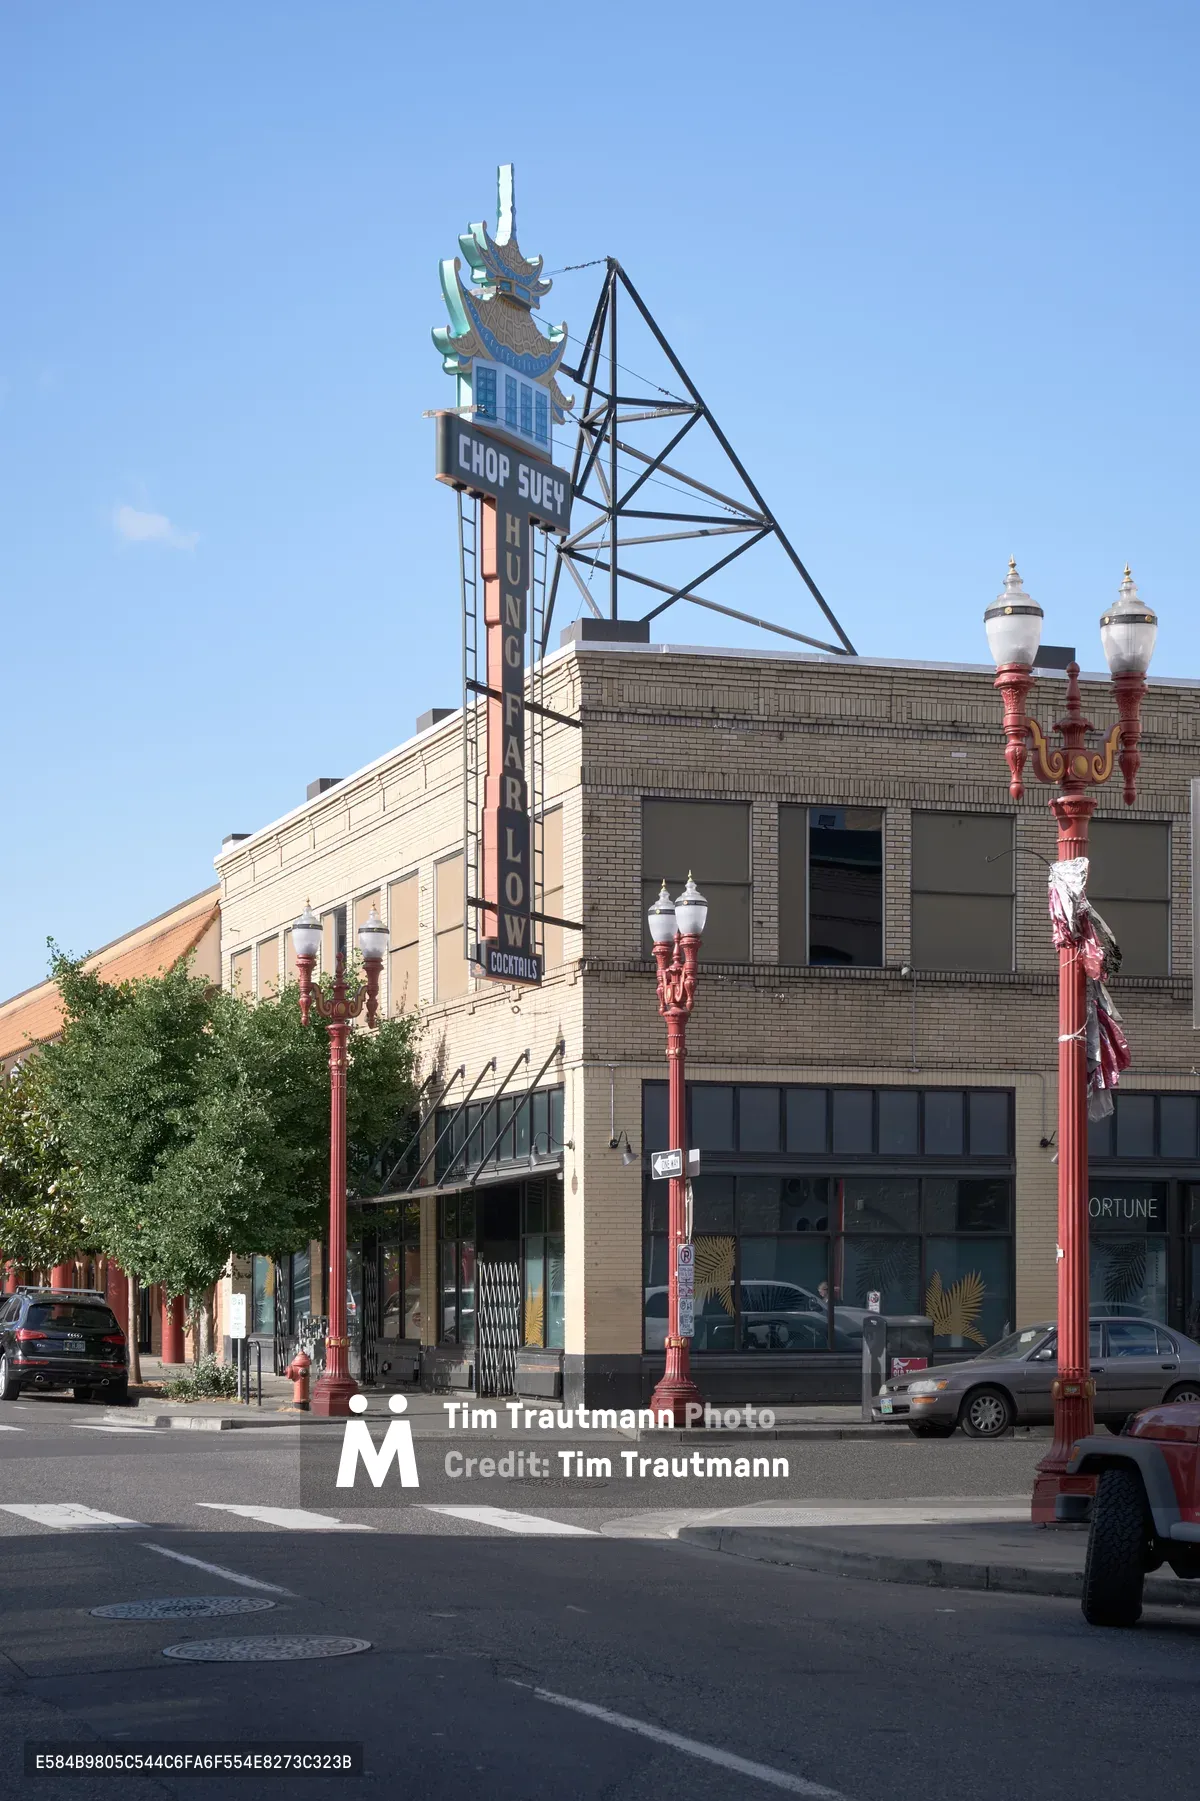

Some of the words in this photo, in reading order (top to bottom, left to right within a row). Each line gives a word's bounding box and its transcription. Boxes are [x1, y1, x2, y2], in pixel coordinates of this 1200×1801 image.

[458, 433, 510, 487] CHOP
[518, 463, 565, 515] SUEY
[505, 513, 522, 668] HUNG
[504, 691, 525, 811] FAR
[504, 827, 527, 948] LOW
[490, 951, 537, 980] COCKTAILS
[661, 1159, 670, 1170] ONE
[1088, 1197, 1158, 1218] ORTUNE
